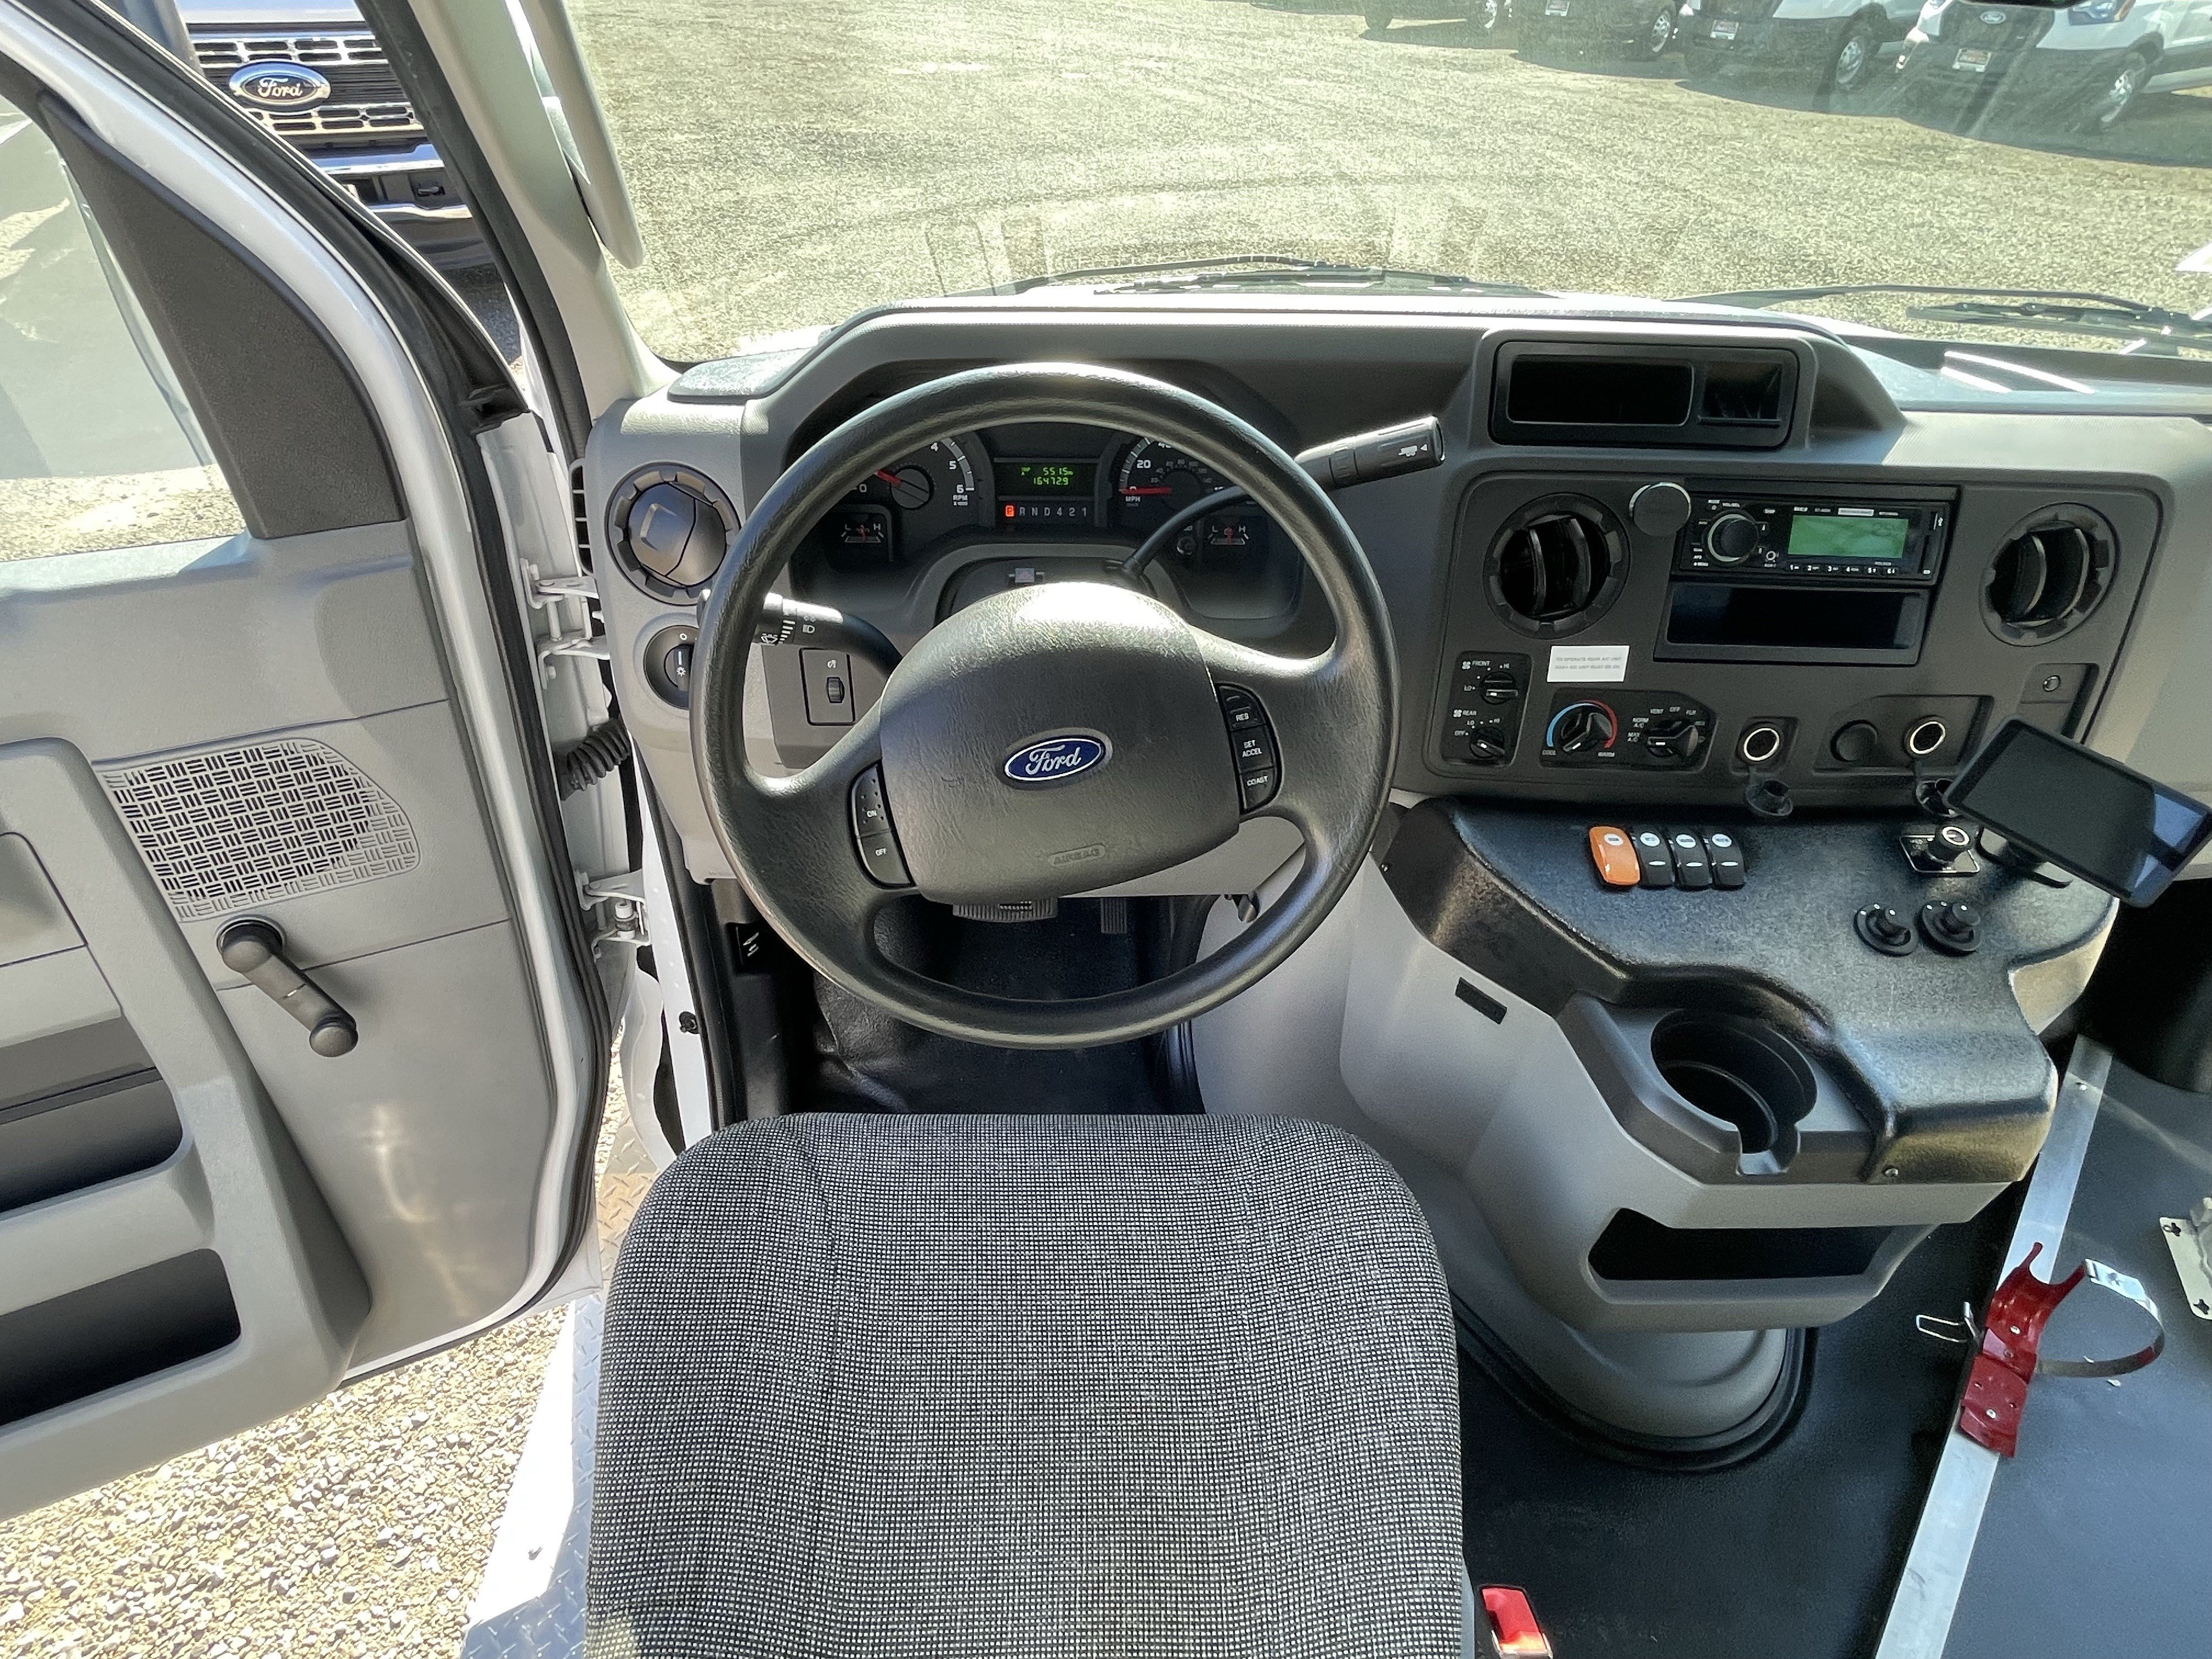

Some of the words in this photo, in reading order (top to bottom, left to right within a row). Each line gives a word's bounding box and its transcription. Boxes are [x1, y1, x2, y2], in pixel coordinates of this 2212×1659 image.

[256, 76, 303, 98] Ford
[930, 442, 938, 452] 4
[949, 461, 957, 470] 5
[1137, 460, 1151, 469] 20
[1034, 476, 1069, 485] 164729
[859, 484, 867, 493] 0
[956, 484, 964, 494] 6
[1031, 507, 1038, 516] N
[1044, 507, 1050, 516] D
[1057, 507, 1063, 516] 4
[1069, 507, 1075, 517] 2
[1082, 507, 1087, 517] 1
[873, 523, 881, 531] H
[1235, 713, 1249, 721] RES
[1244, 740, 1256, 749] SET
[1242, 747, 1262, 758] ACCEL
[1025, 744, 1082, 775] Ford
[1246, 776, 1268, 787] COAST
[867, 809, 877, 817] ON
[874, 848, 887, 856] OFF
